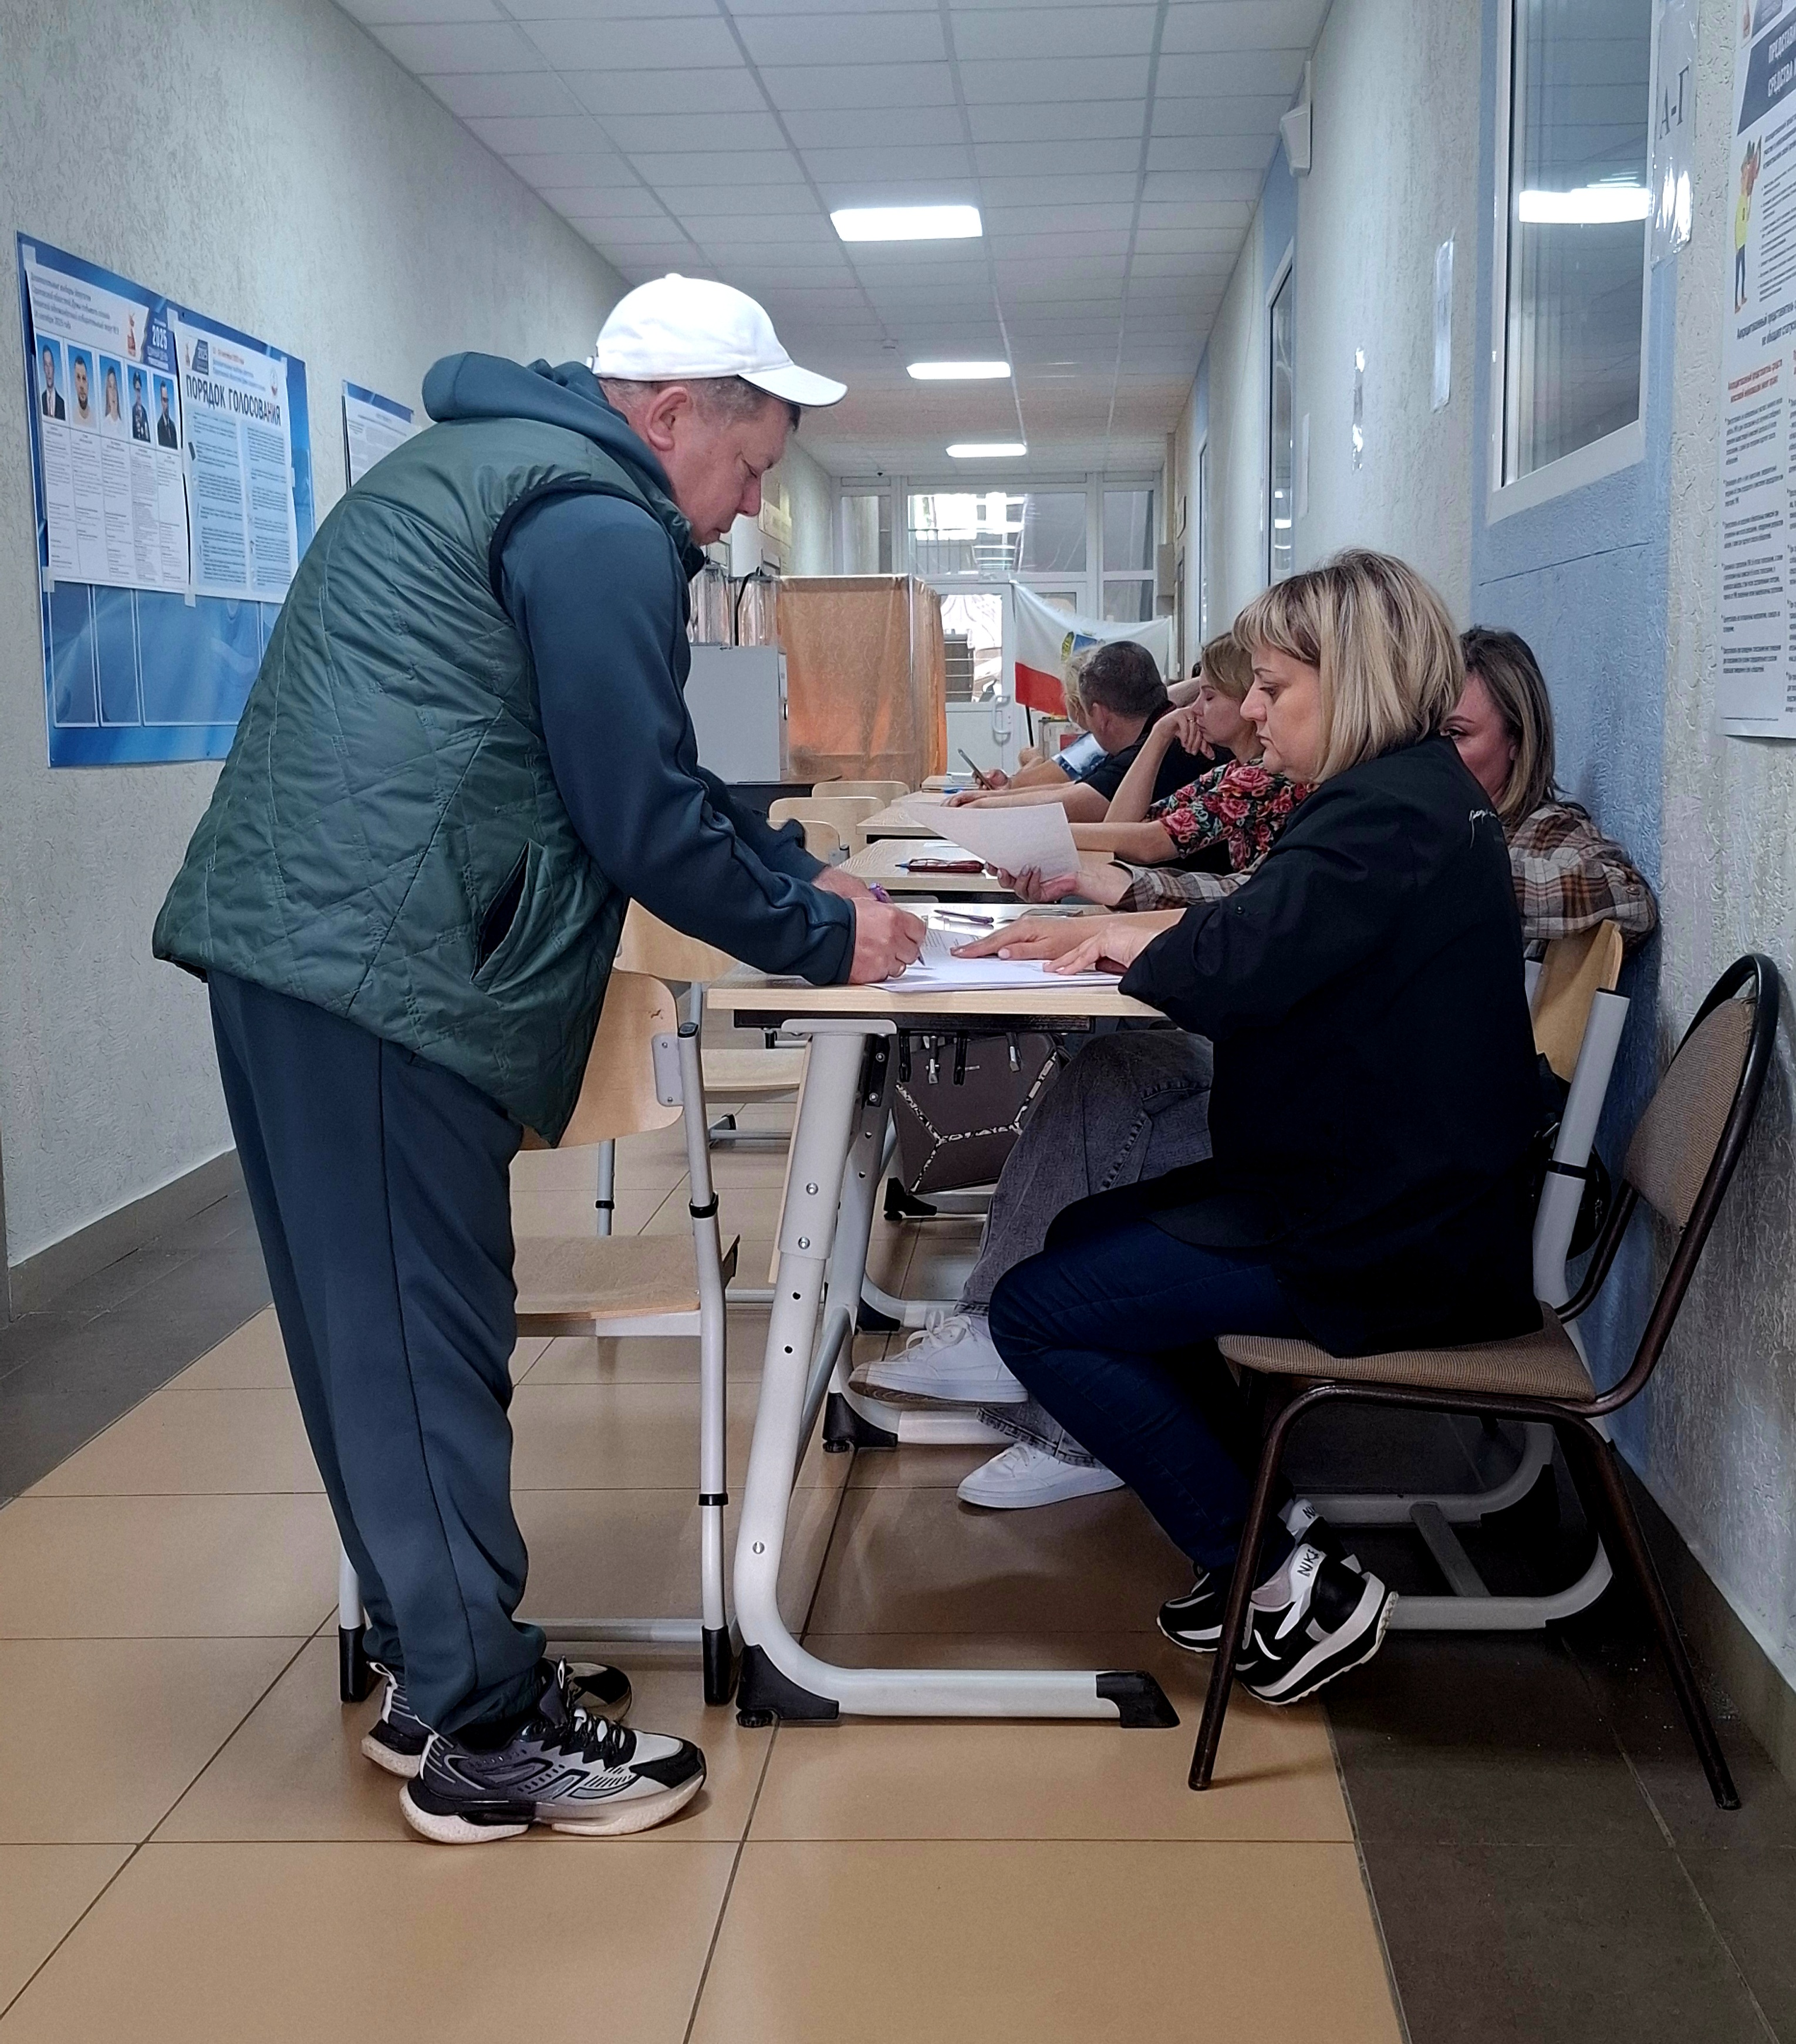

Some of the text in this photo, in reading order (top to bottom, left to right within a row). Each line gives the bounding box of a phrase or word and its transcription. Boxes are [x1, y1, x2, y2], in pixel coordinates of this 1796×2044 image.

[152, 325, 167, 350] 2025
[185, 374, 226, 410] ПОРЯДОК
[228, 388, 281, 426] ГОЛОСОВАНИЯ
